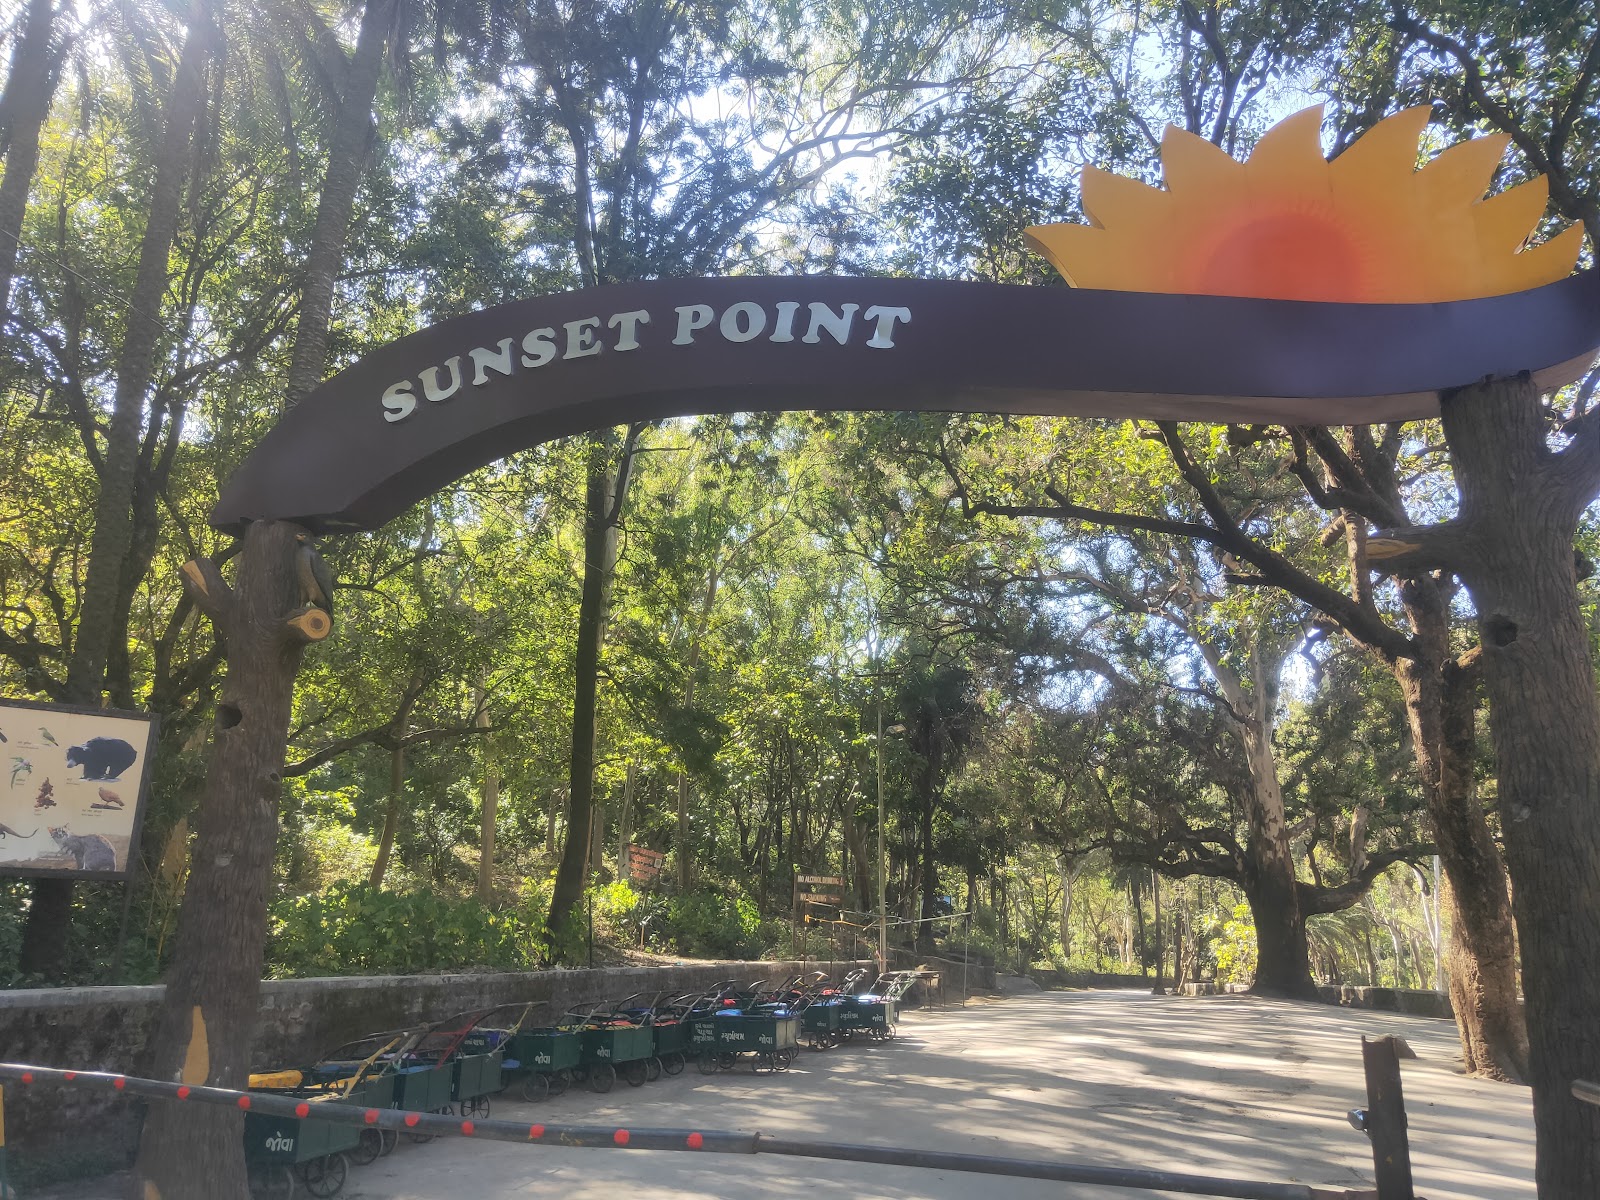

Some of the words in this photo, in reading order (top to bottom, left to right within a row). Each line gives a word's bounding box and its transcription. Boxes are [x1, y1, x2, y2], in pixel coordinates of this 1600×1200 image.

[381, 309, 651, 423] SUNSET
[671, 301, 912, 349] POINT
[265, 1130, 294, 1152] જોવા
